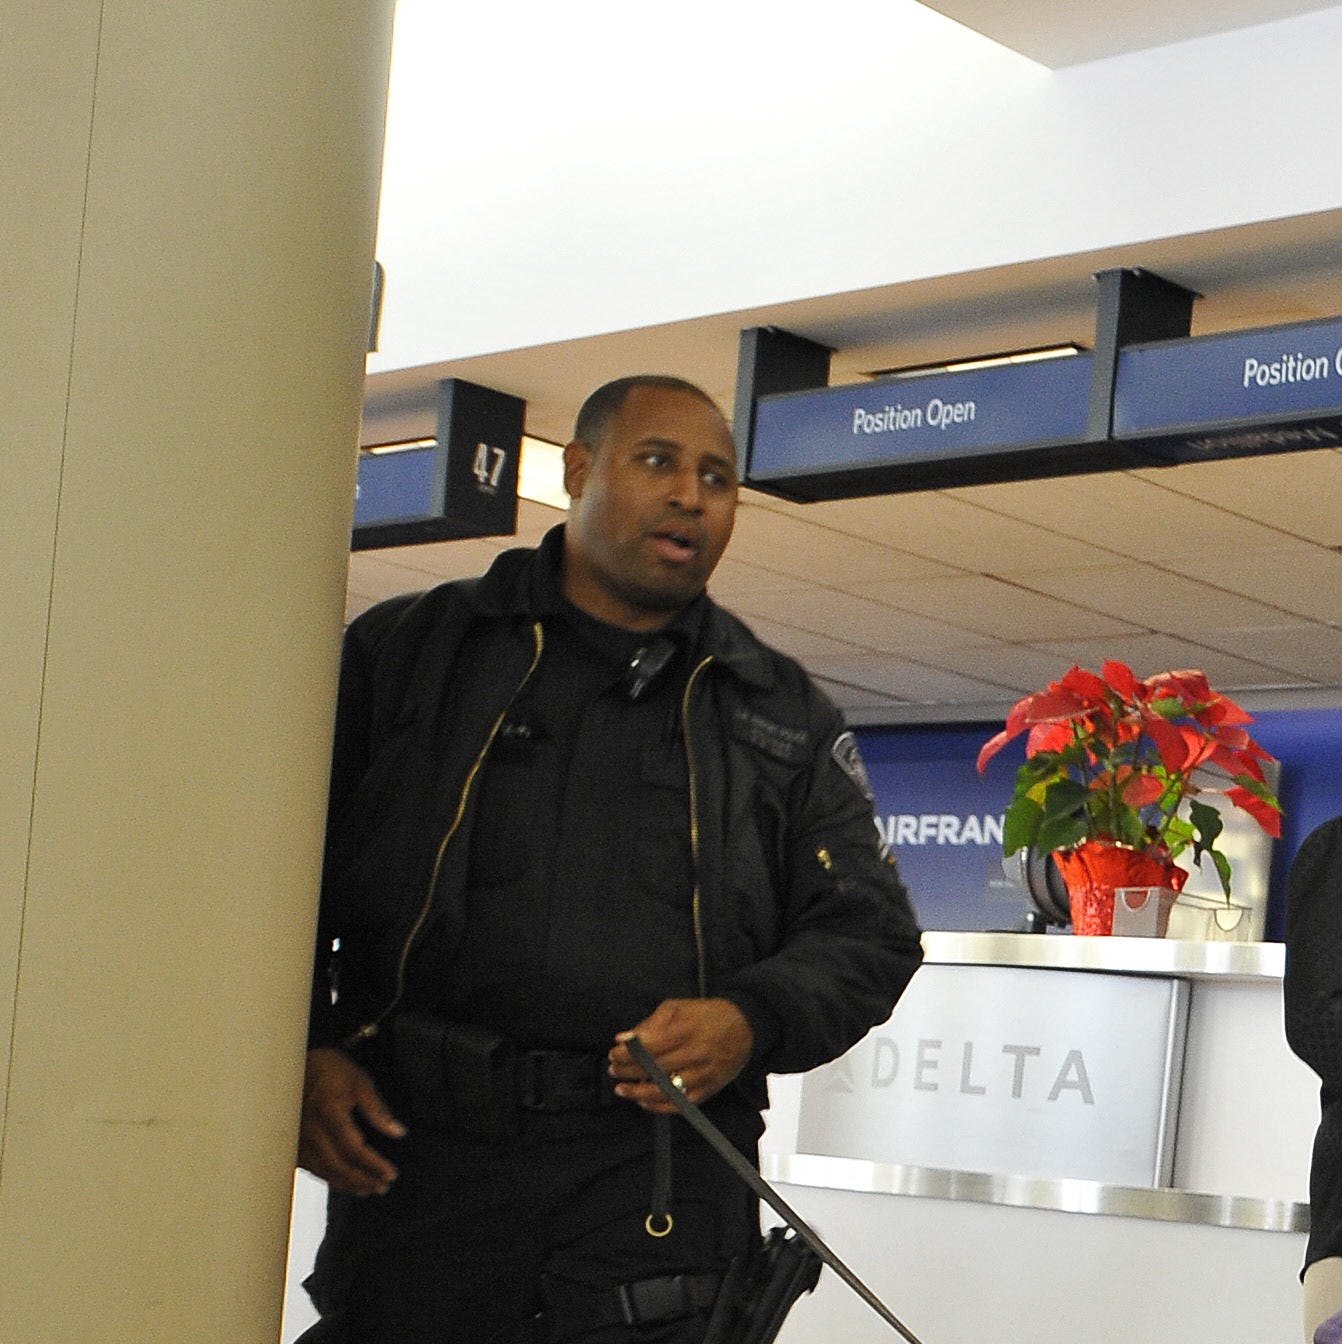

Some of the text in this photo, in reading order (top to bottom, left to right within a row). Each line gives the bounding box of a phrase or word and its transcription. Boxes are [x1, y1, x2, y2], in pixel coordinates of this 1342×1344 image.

[1242, 352, 1330, 389] Position
[852, 397, 976, 435] Position Open
[472, 442, 505, 487] 47
[871, 1036, 1097, 1106] DELTA
